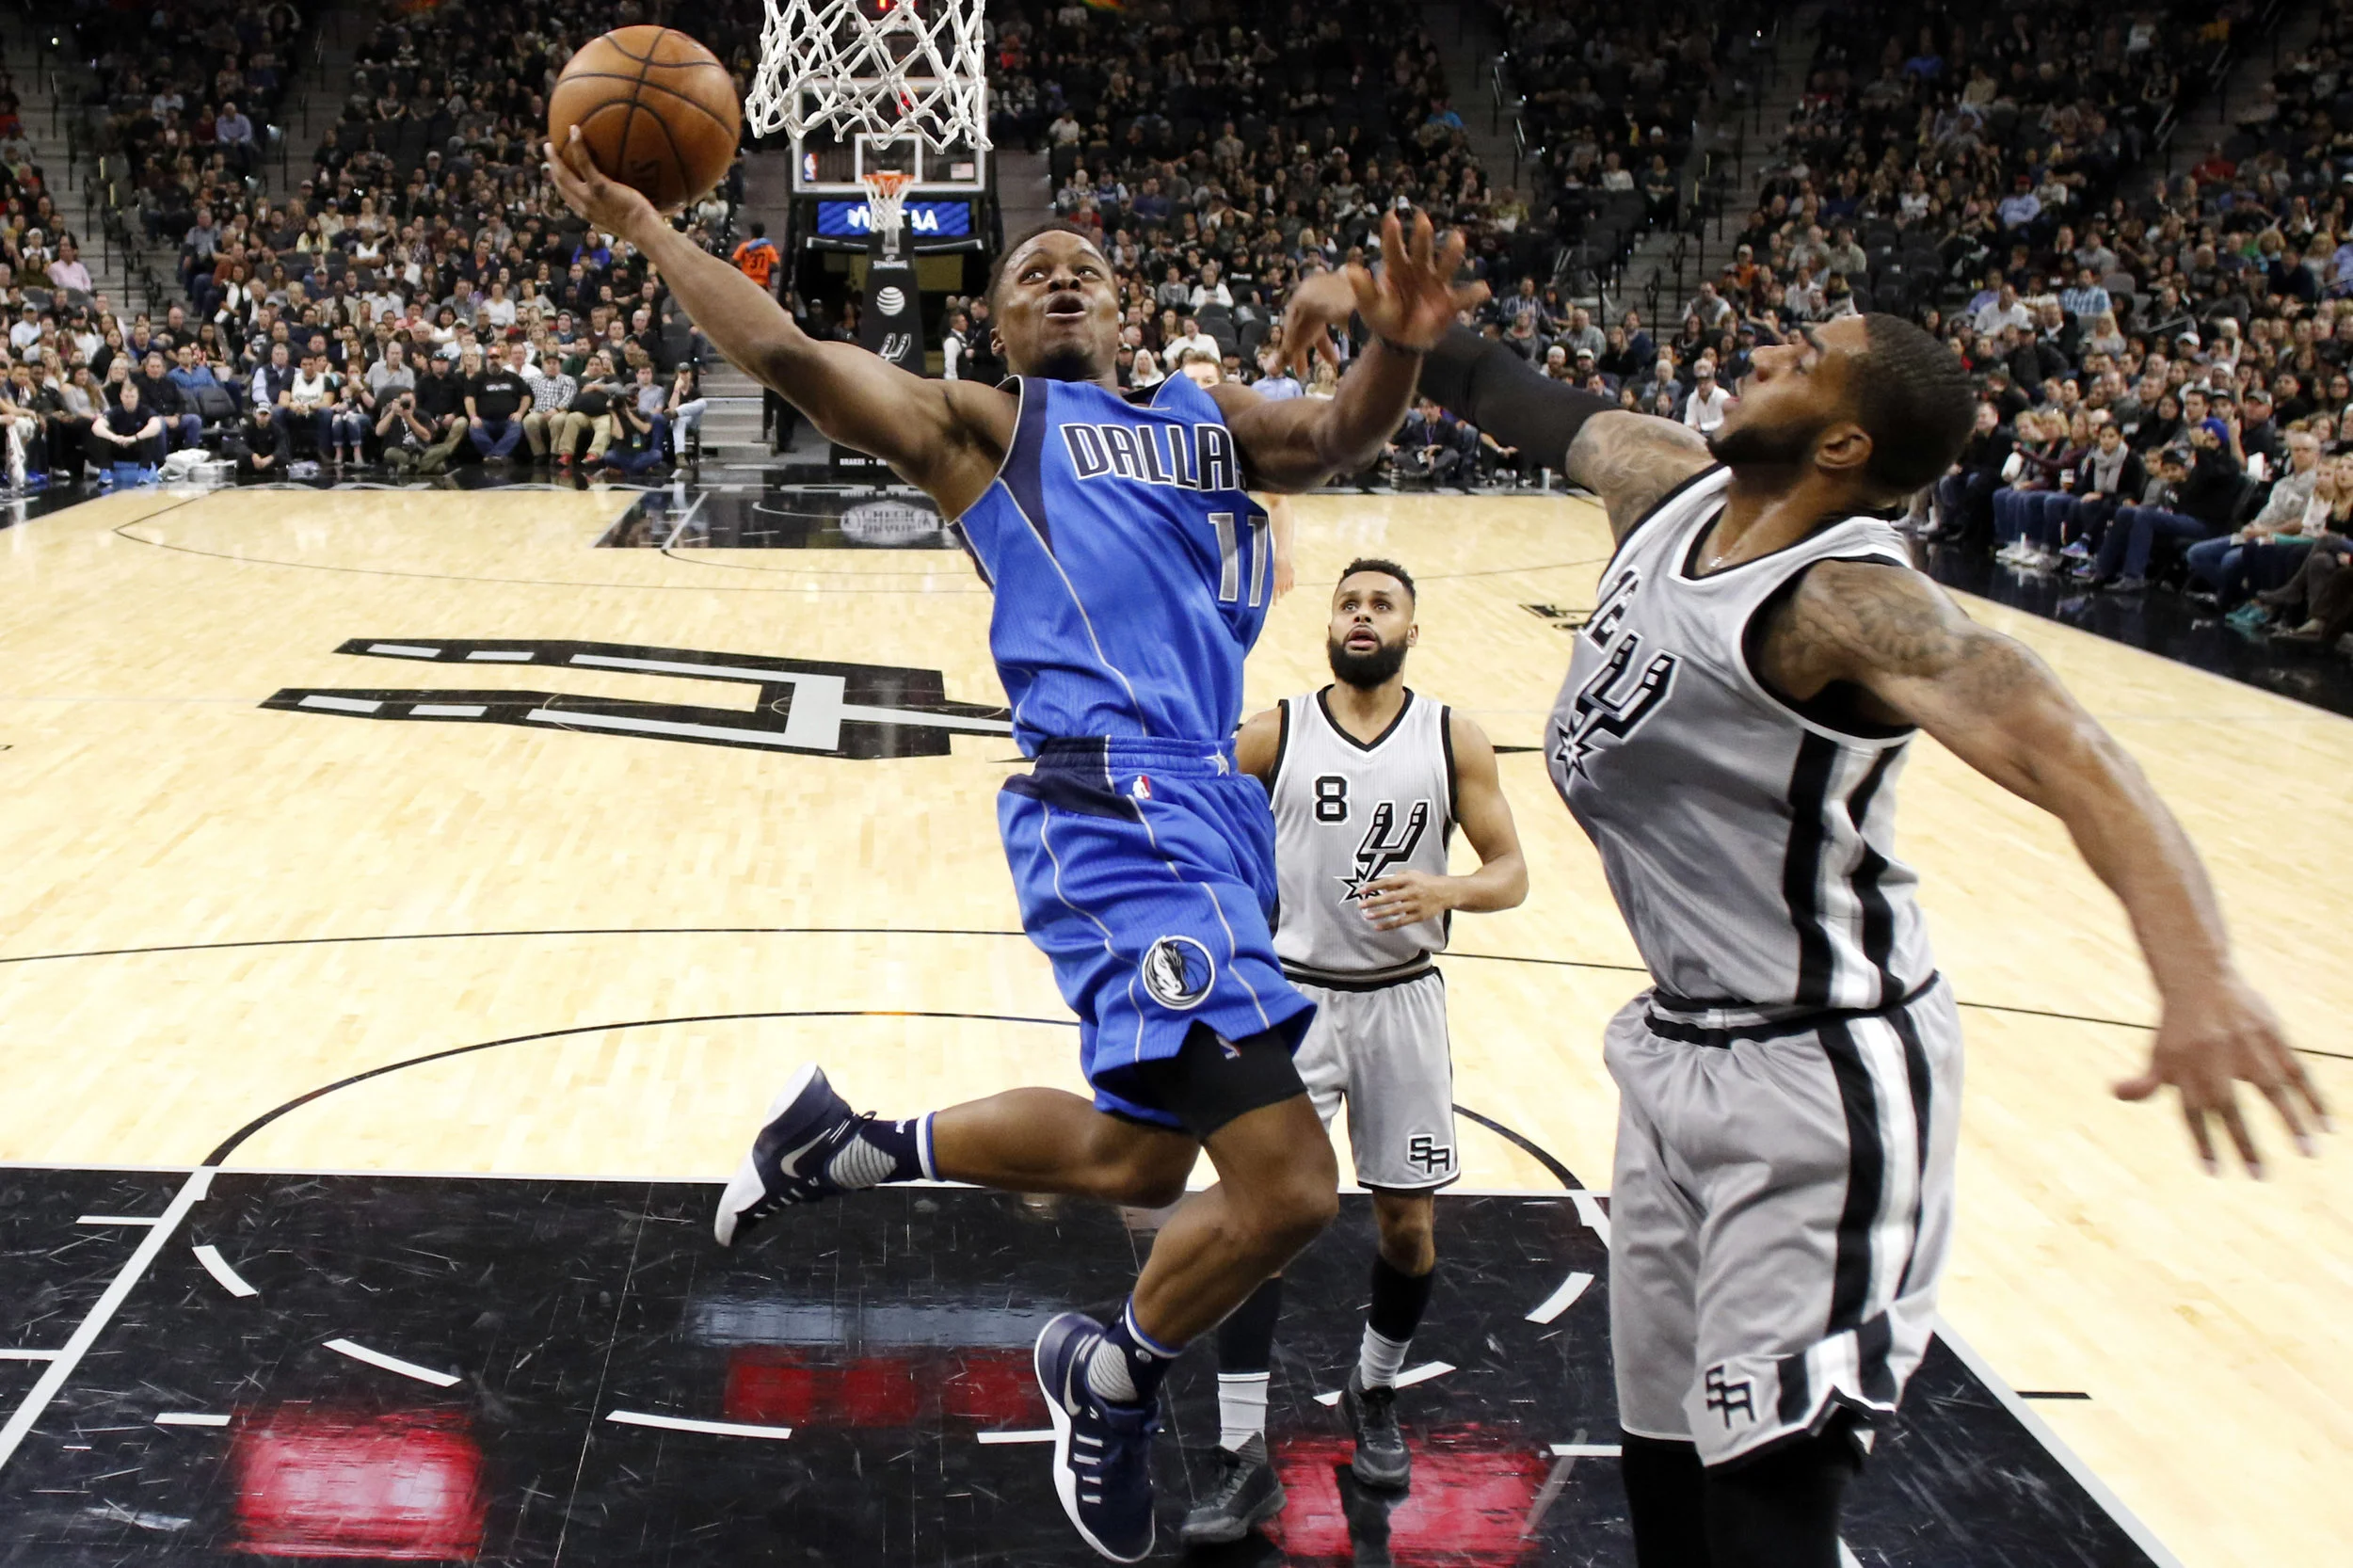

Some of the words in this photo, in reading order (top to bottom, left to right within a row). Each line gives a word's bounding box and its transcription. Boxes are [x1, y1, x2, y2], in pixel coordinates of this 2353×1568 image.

[1060, 423, 1247, 492] DALLA
[1209, 512, 1269, 608] 11
[1313, 775, 1350, 824] 8
